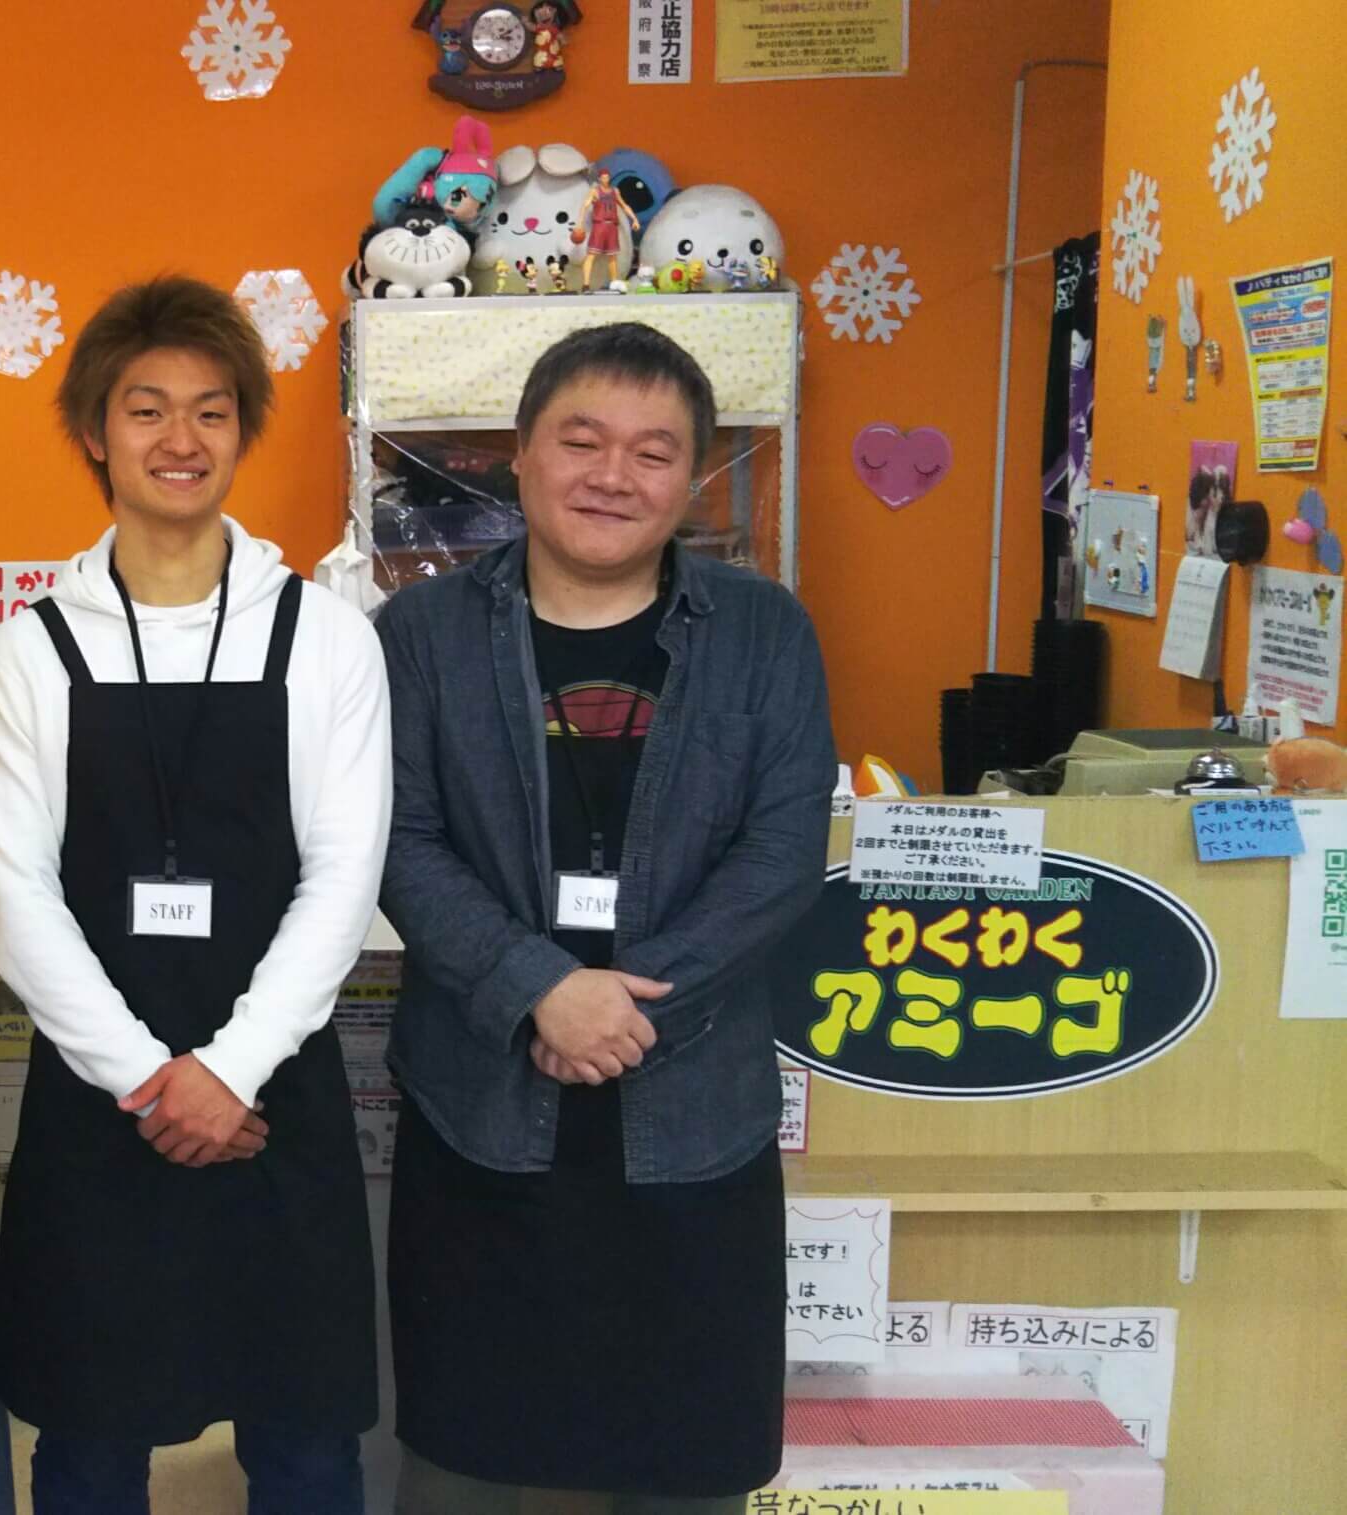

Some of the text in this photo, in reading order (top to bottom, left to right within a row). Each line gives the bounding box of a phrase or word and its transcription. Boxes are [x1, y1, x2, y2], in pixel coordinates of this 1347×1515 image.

[660, 0, 682, 77] 止協力店
[885, 805, 1002, 819] メダルご利用のお客様へ
[891, 824, 1008, 840] 本日はメダルの貸出を
[905, 853, 986, 868] ご了承ください。
[149, 903, 196, 920] STAFF
[863, 904, 1083, 969] わくわく
[808, 967, 1133, 1060] アミーゴ
[969, 1317, 1156, 1349] 持ち込みによる
